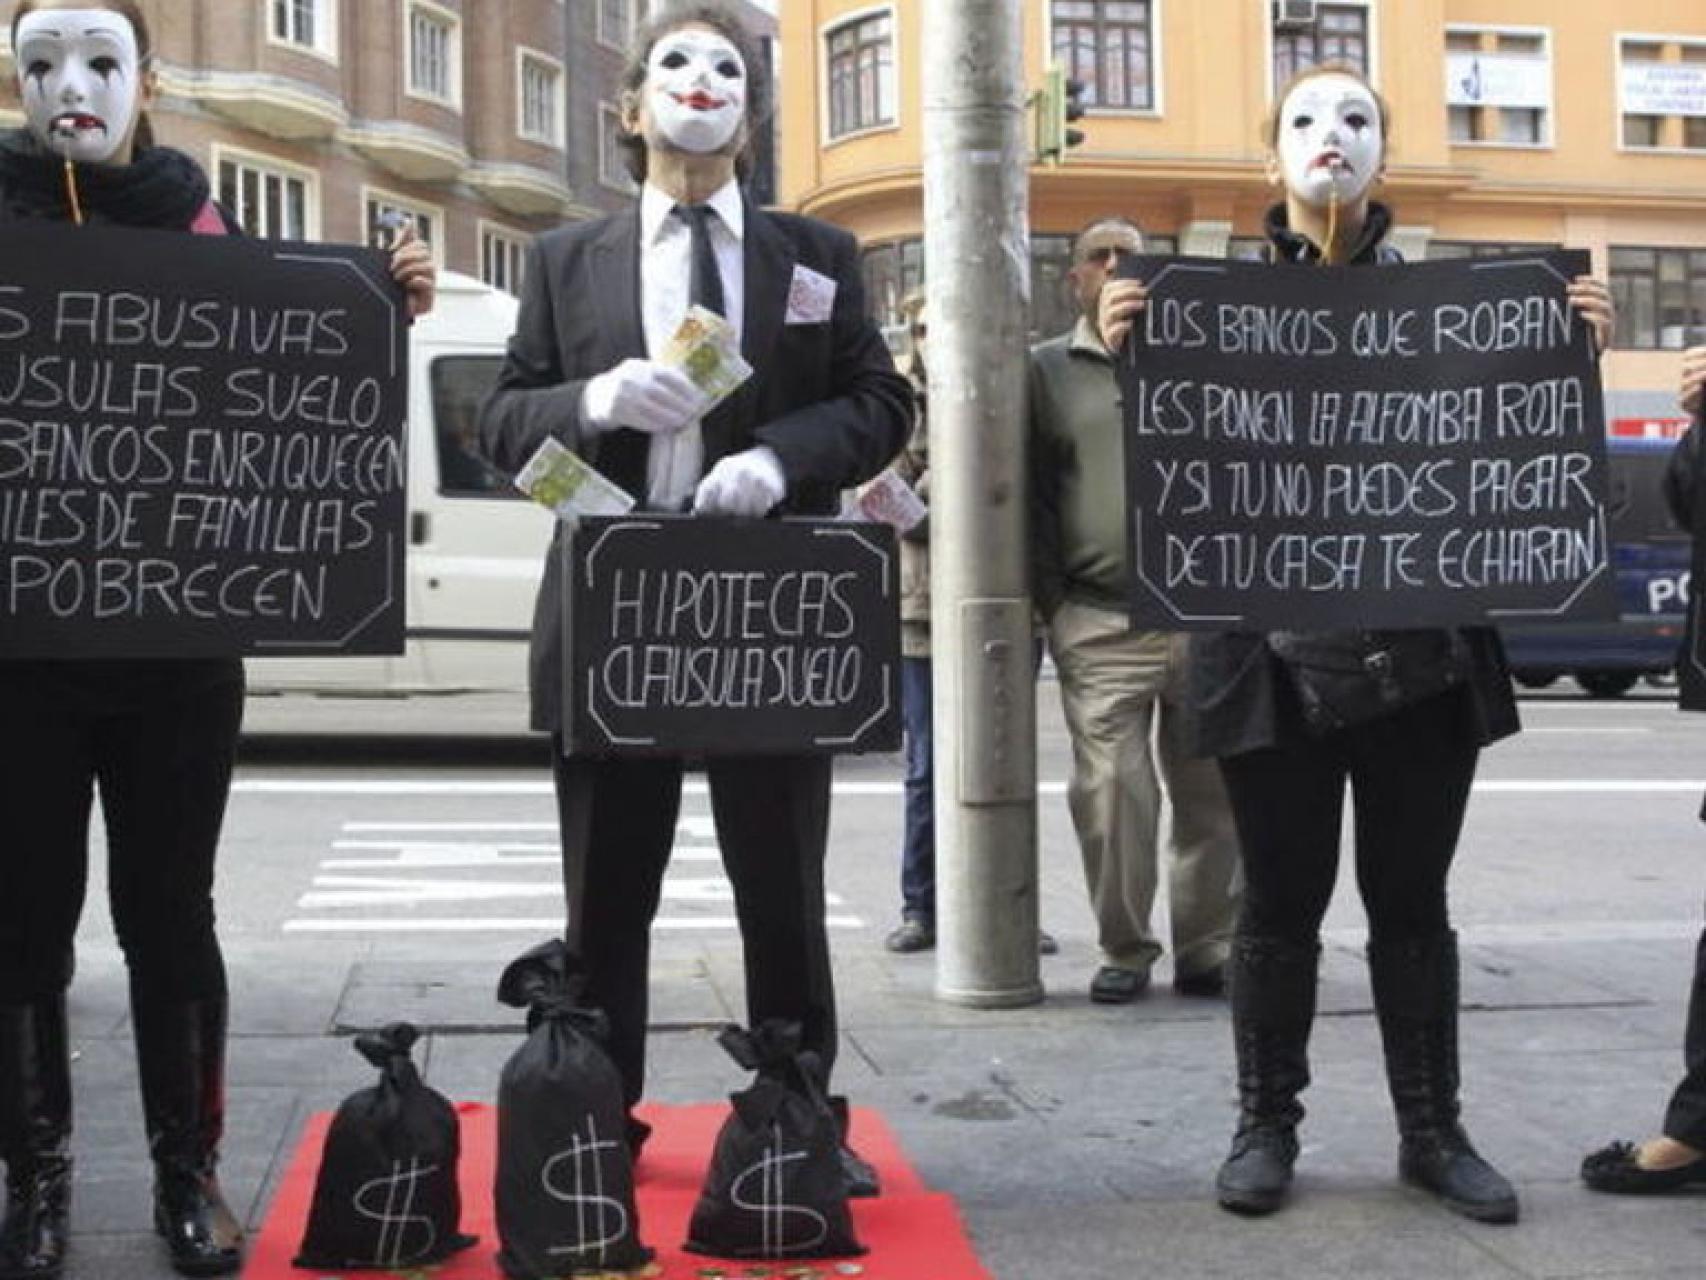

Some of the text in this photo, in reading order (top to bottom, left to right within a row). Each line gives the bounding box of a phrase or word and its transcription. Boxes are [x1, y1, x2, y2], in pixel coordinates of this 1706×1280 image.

[55, 291, 349, 354] ABUSIVAS
[1146, 297, 1572, 357] LOS BANCOS QUE ROBAN
[223, 368, 381, 428] SUELO
[1137, 379, 1195, 435] LES
[1202, 383, 1293, 445] PONEN
[1308, 391, 1341, 447] LA
[1497, 377, 1583, 438] ROJA
[184, 420, 408, 494] ENRIQUECEN
[1225, 459, 1267, 517] TU
[1273, 462, 1311, 518] NO
[1323, 459, 1457, 518] PUEDES
[1469, 452, 1596, 516] PAGAR
[98, 491, 150, 550] DE
[166, 493, 376, 554] FAMILIAS
[1266, 533, 1367, 591] CASA
[1379, 532, 1424, 591] TE
[1439, 516, 1596, 588] ECHARAN
[612, 569, 859, 639] HIPOTECAS
